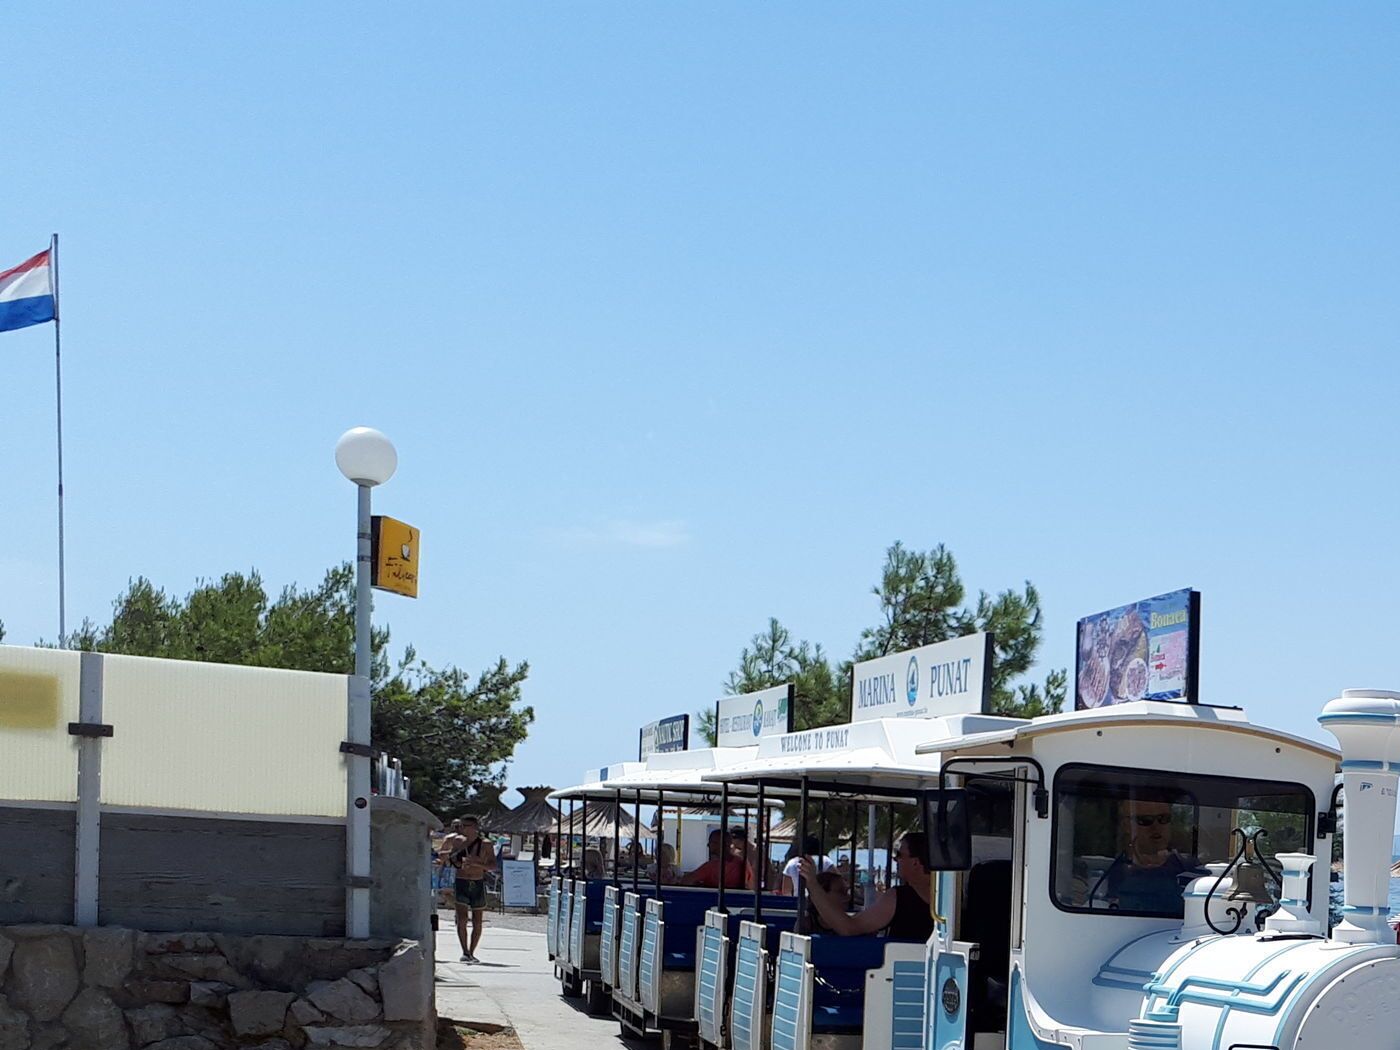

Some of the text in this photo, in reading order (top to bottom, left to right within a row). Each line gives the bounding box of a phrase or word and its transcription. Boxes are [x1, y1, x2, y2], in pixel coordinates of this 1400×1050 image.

[858, 658, 971, 708] MARINA PUNAT
[781, 729, 849, 752] WELCOME TO PUNAT
